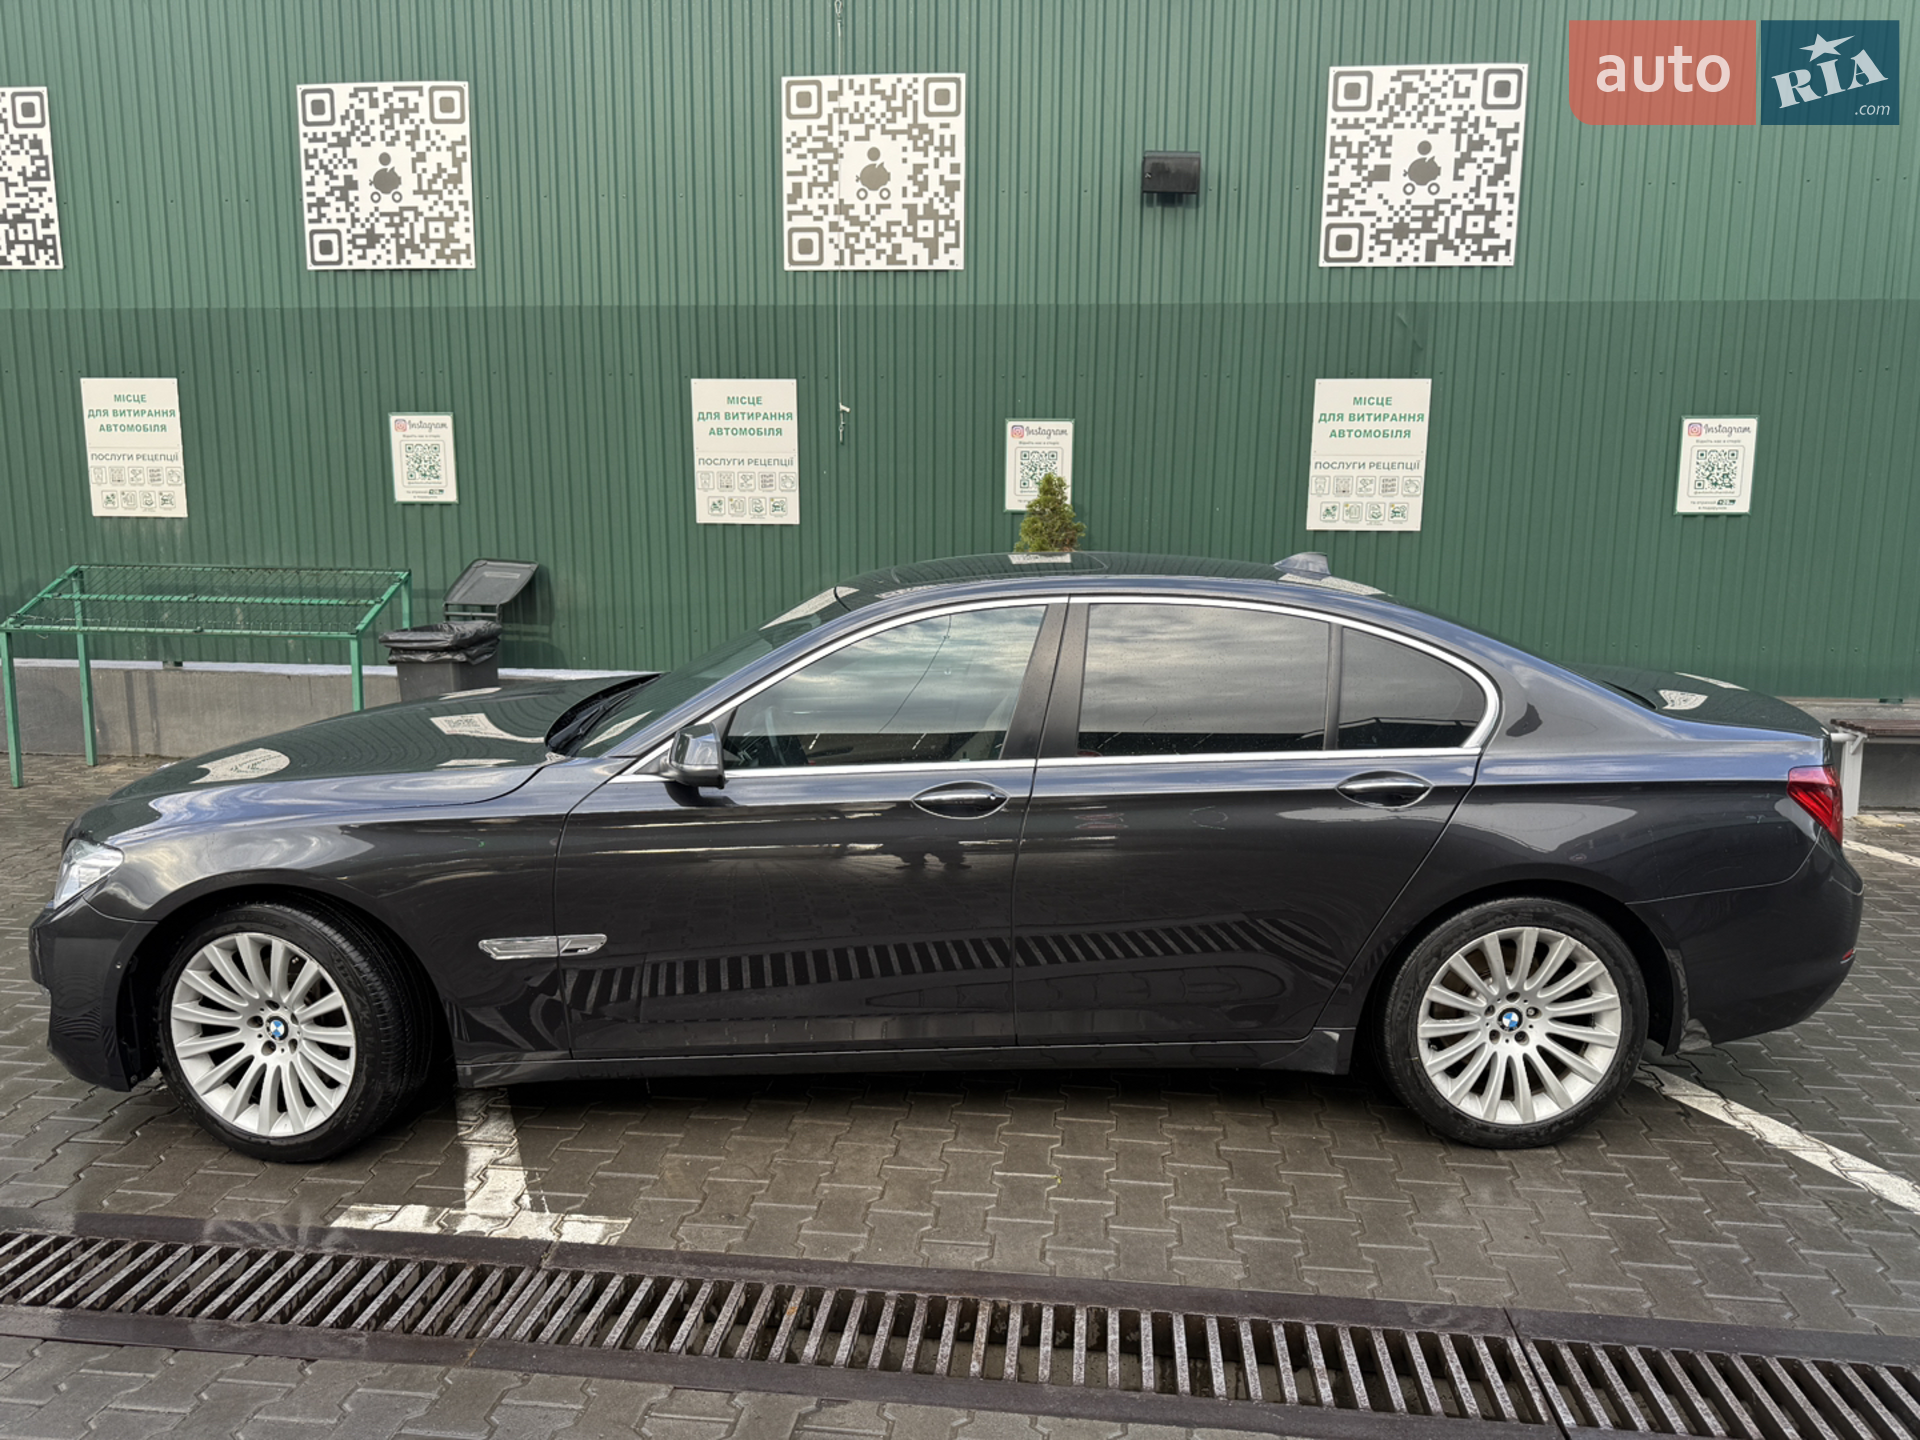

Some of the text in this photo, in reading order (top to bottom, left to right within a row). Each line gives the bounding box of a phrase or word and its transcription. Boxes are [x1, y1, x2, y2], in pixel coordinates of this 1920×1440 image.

[114, 394, 147, 404] МІСЦЕ
[726, 396, 763, 406] МІСЦЕ
[1353, 396, 1393, 407] МІСЦЕ
[87, 409, 176, 419] ДЛЯ ВИТИРАННЯ
[697, 411, 793, 422] ДЛЯ ВИТИРАННЯ
[1318, 413, 1425, 423] ДЛЯ ВИТИРАННЯ
[99, 424, 168, 433] АВТОМОБІЛЯ
[407, 420, 448, 432] Instagram
[1703, 423, 1751, 437] Instagram
[708, 427, 783, 437] АВТОМОБІЛЯ
[1025, 426, 1068, 439] Instagram
[1329, 429, 1412, 439] АВТОМОБІЛЯ
[90, 452, 179, 462] ПОСЛУГИ РЕЦЕПЦІЇ
[698, 457, 794, 467] ПОСЛУГИ РЕЦЕПЦІЇ
[1314, 460, 1421, 471] ПОСЛУГИ РЕЦЕПЦІЇ
